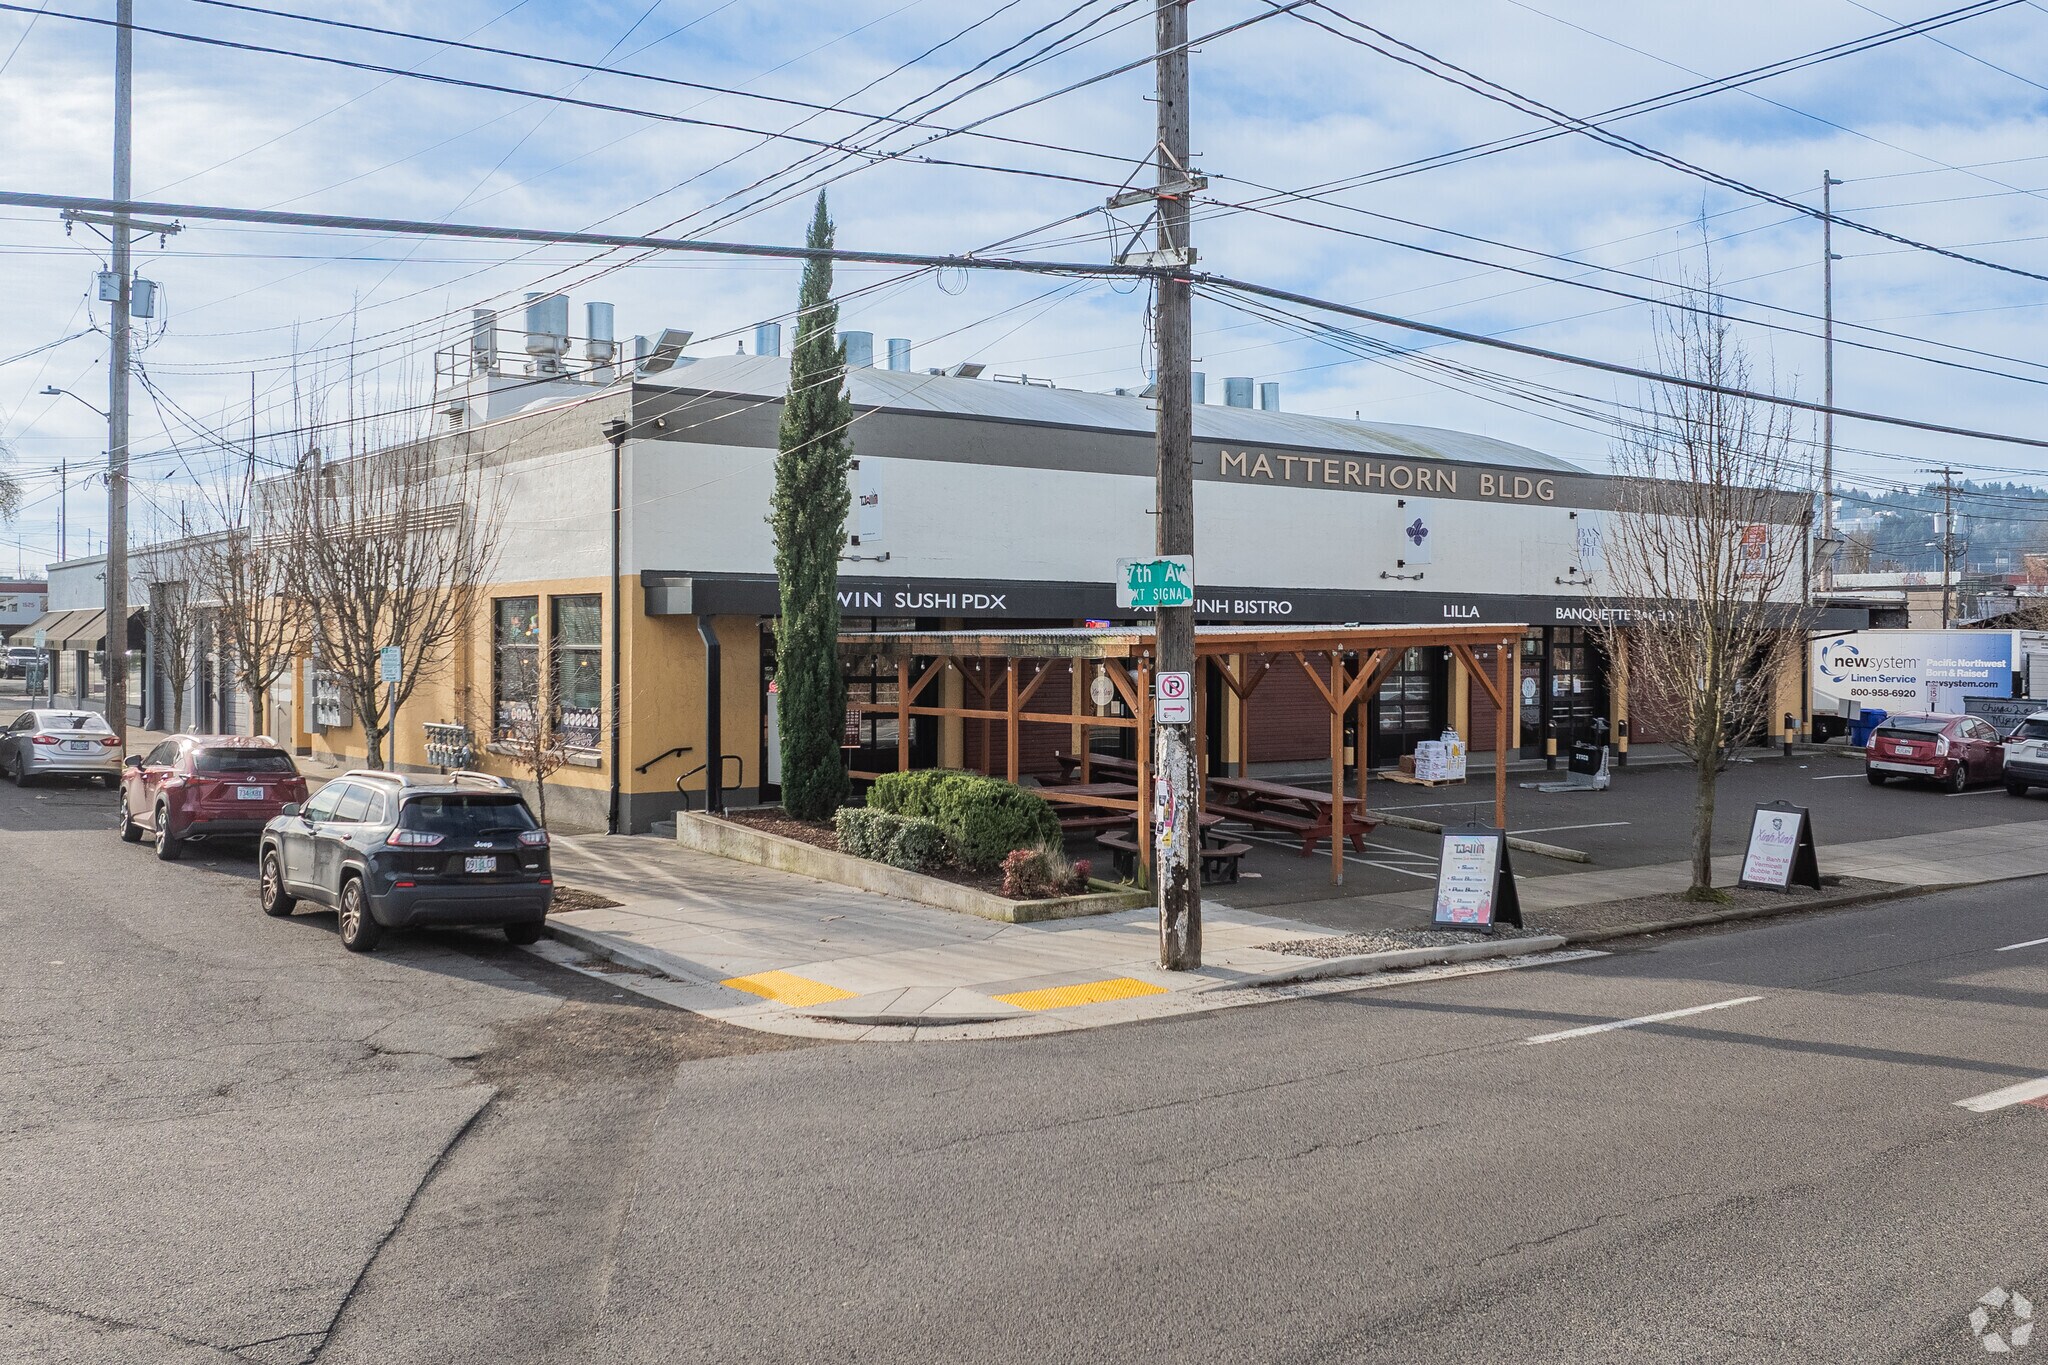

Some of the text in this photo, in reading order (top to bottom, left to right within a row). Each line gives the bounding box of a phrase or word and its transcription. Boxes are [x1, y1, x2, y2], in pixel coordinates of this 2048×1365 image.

[1219, 450, 1555, 501] MATTERHORN BLDG
[1153, 588, 1189, 601] SIGNAL
[837, 591, 1007, 610] WIN SUSHI PDX
[1194, 600, 1293, 614] INH BISTRO
[1443, 604, 1480, 618] LILLA
[1555, 607, 1631, 621] BANQUETTE
[1834, 656, 1917, 671] newsystem
[1926, 659, 2006, 668] Pacific Northwest
[1851, 674, 1917, 683] Linen Service
[1926, 669, 1989, 678] Born & Raised
[1850, 688, 1916, 697] 800-958-6920
[1754, 861, 1783, 869] Vermicelli
[1750, 867, 1771, 875] Bubble
[1748, 874, 1766, 882] Happy
